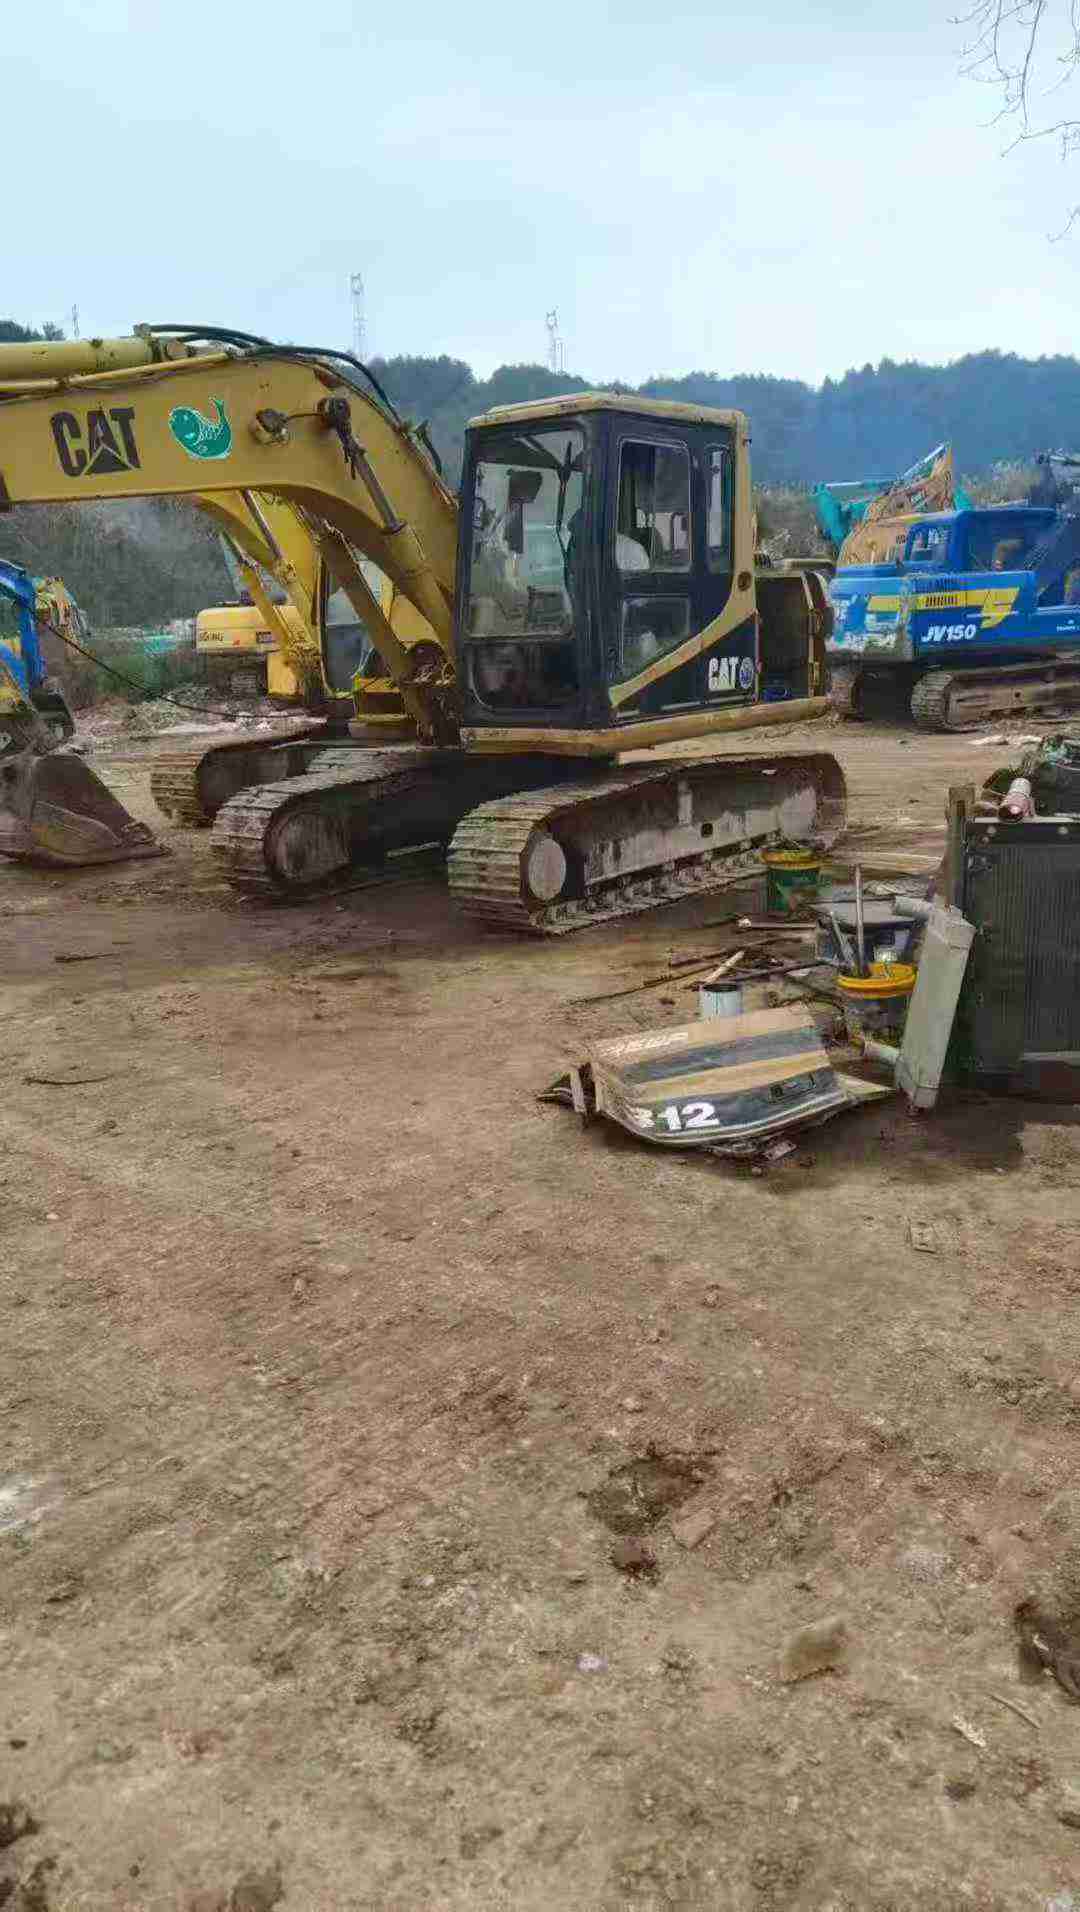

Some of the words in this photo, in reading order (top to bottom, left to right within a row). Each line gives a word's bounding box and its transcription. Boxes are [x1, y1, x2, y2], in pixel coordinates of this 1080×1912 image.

[51, 408, 141, 476] CAT
[921, 624, 977, 642] JV150
[708, 656, 739, 691] CAT
